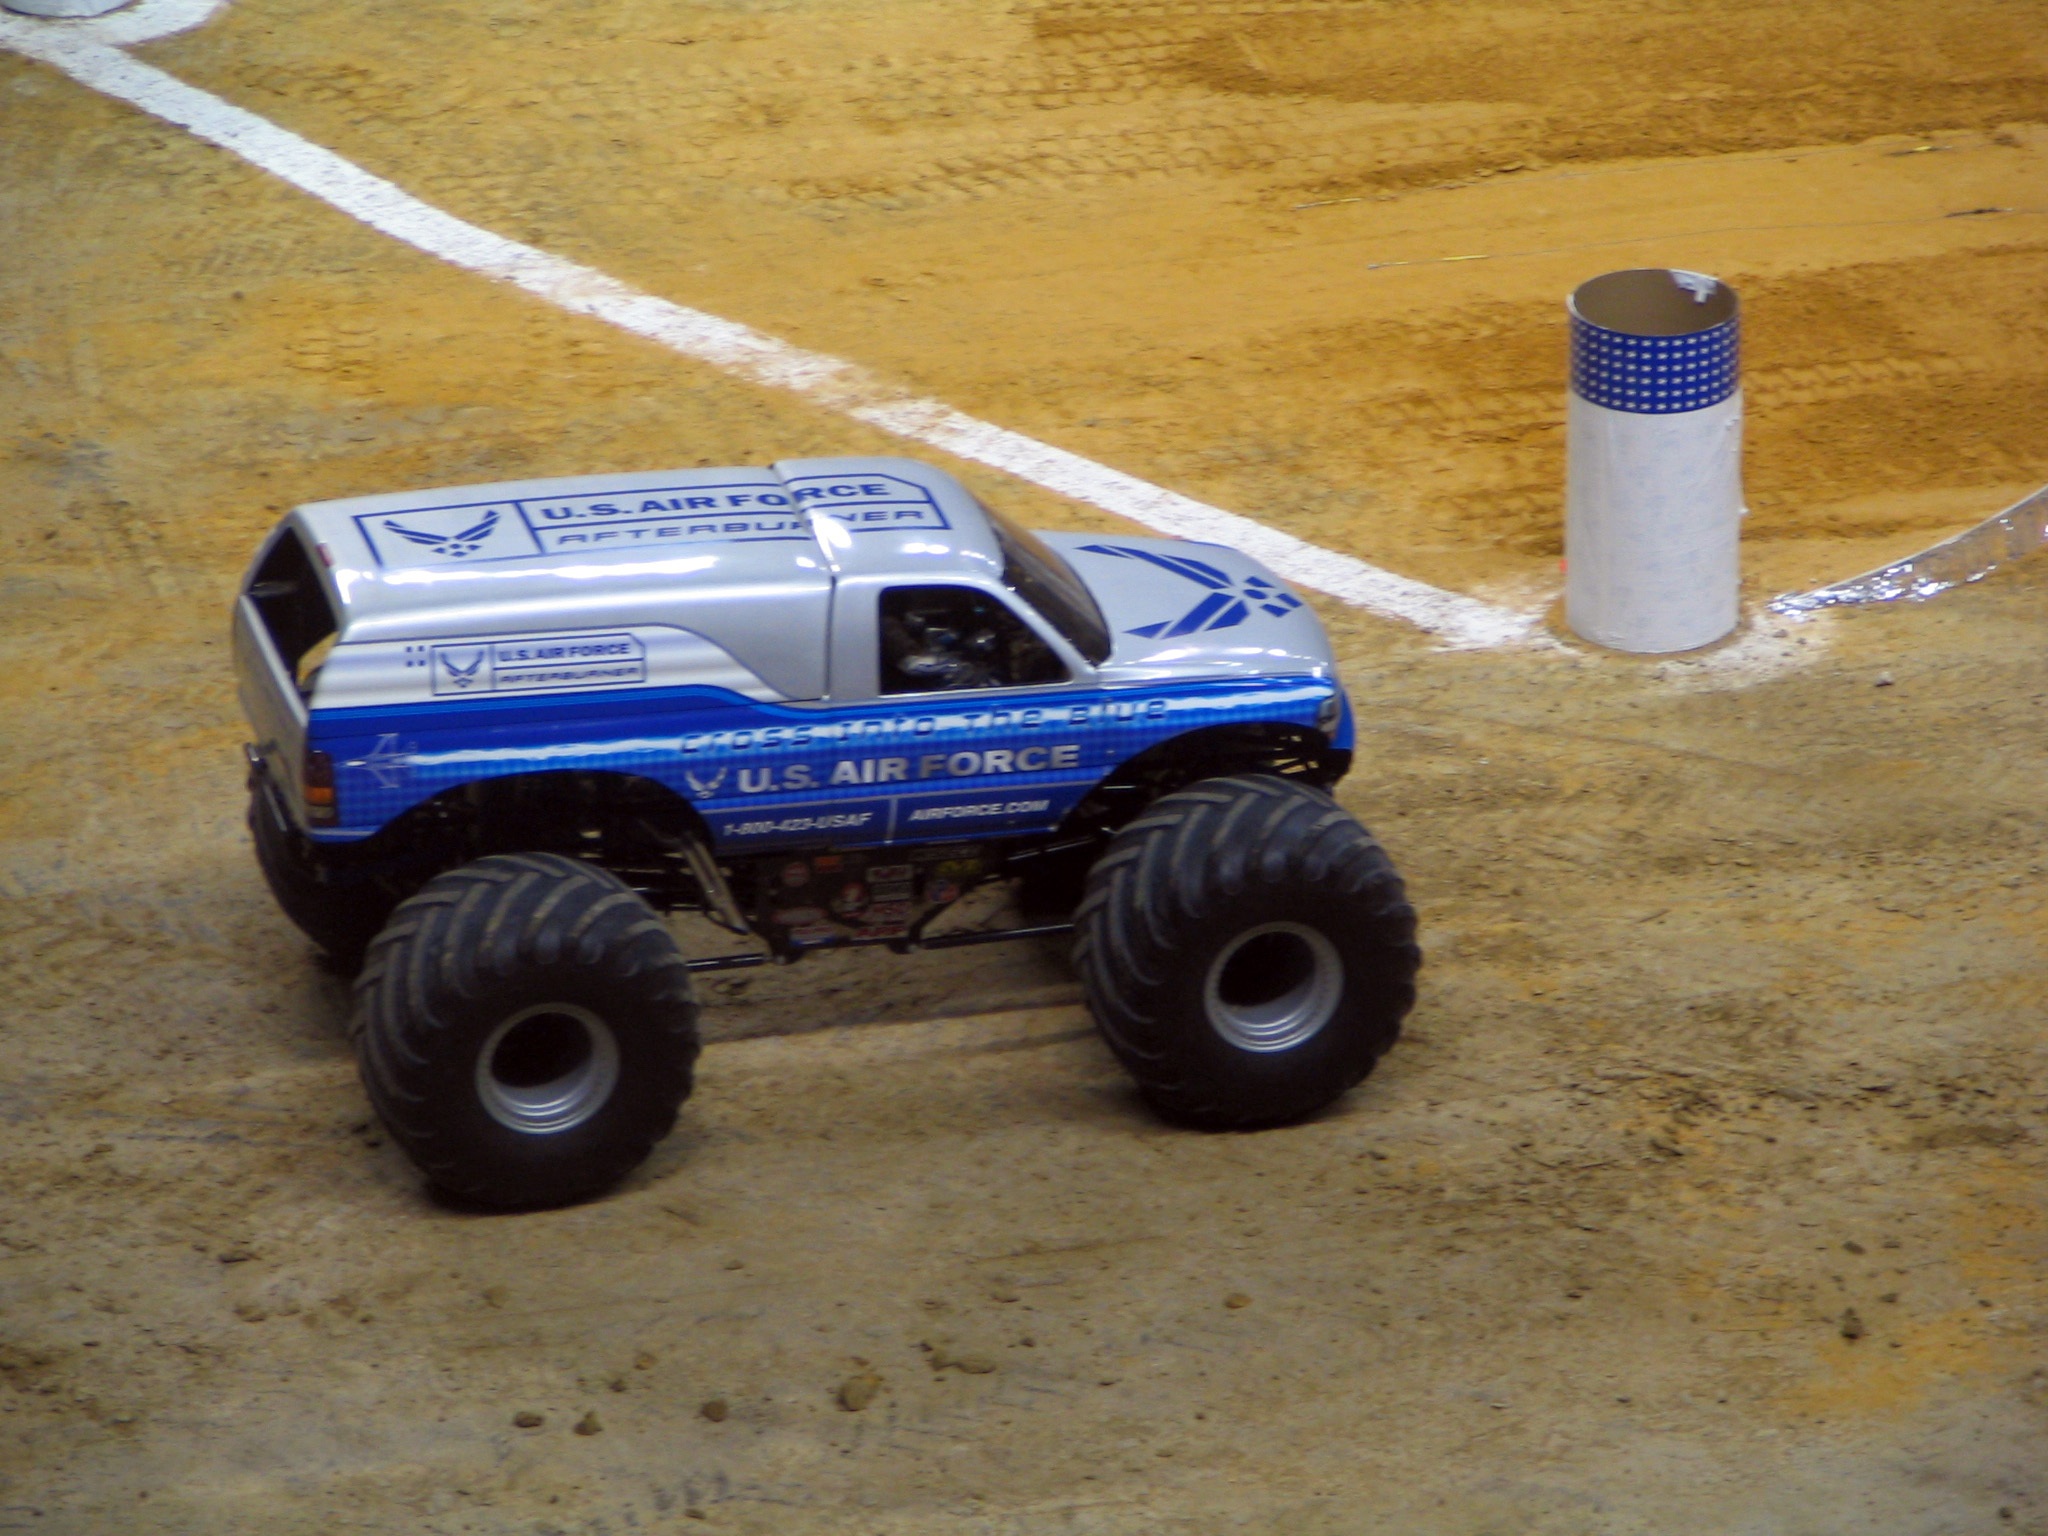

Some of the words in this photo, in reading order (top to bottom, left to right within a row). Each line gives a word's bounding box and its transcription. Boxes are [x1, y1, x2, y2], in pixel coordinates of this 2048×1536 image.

[540, 502, 632, 520] U.S.
[639, 496, 717, 513] AIR
[725, 483, 891, 508] FORCE
[568, 643, 631, 657] FORCE
[736, 763, 821, 794] U.S.
[828, 756, 909, 786] AIR
[918, 744, 1081, 779] FORCE
[907, 800, 1051, 821] AIRFORCE.COM
